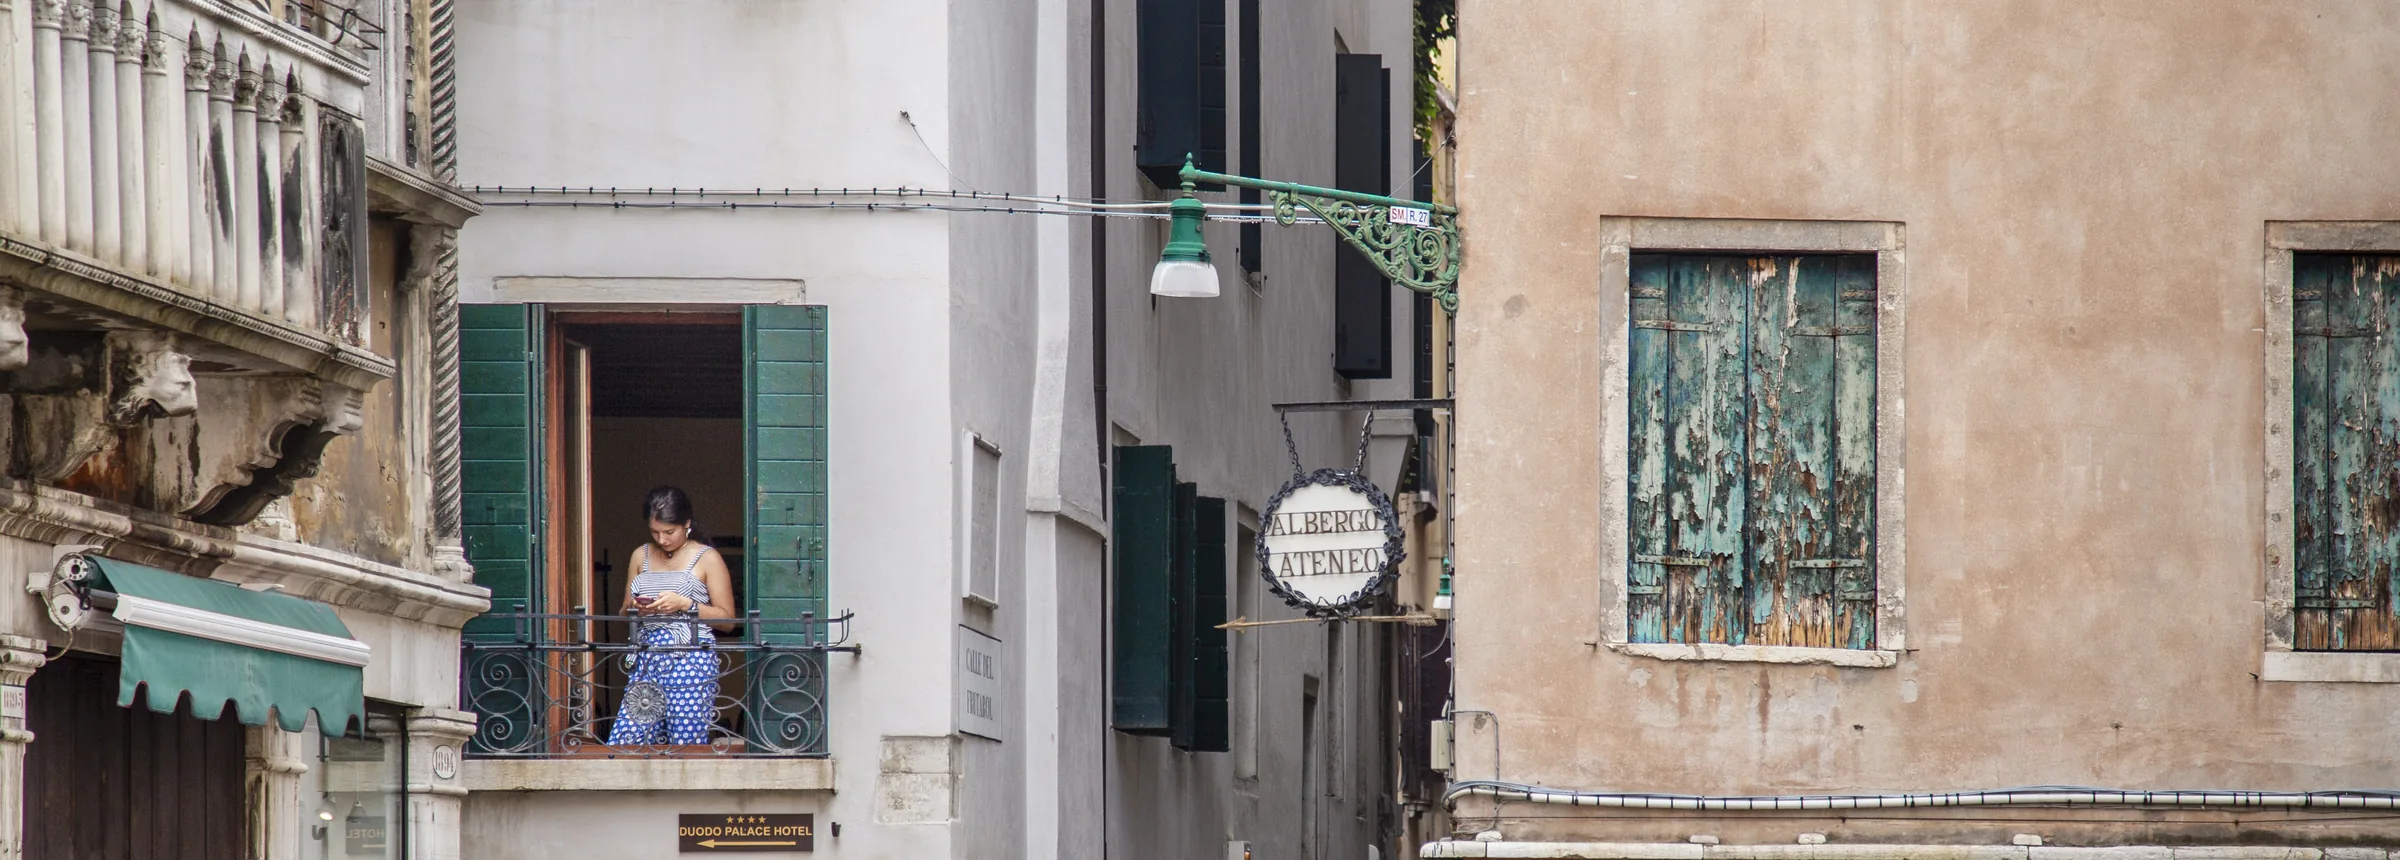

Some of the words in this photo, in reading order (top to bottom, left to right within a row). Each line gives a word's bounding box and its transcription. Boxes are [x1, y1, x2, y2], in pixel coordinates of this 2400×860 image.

[1419, 211, 1428, 223] 27
[1271, 509, 1378, 536] ALBERGO
[1280, 548, 1379, 577] ATENEO
[966, 648, 982, 676] CALLE
[983, 654, 993, 680] DEL
[435, 751, 454, 773] 1894
[679, 826, 722, 837] DUODO
[725, 826, 771, 837] PALACE
[774, 826, 813, 837] HOTEL
